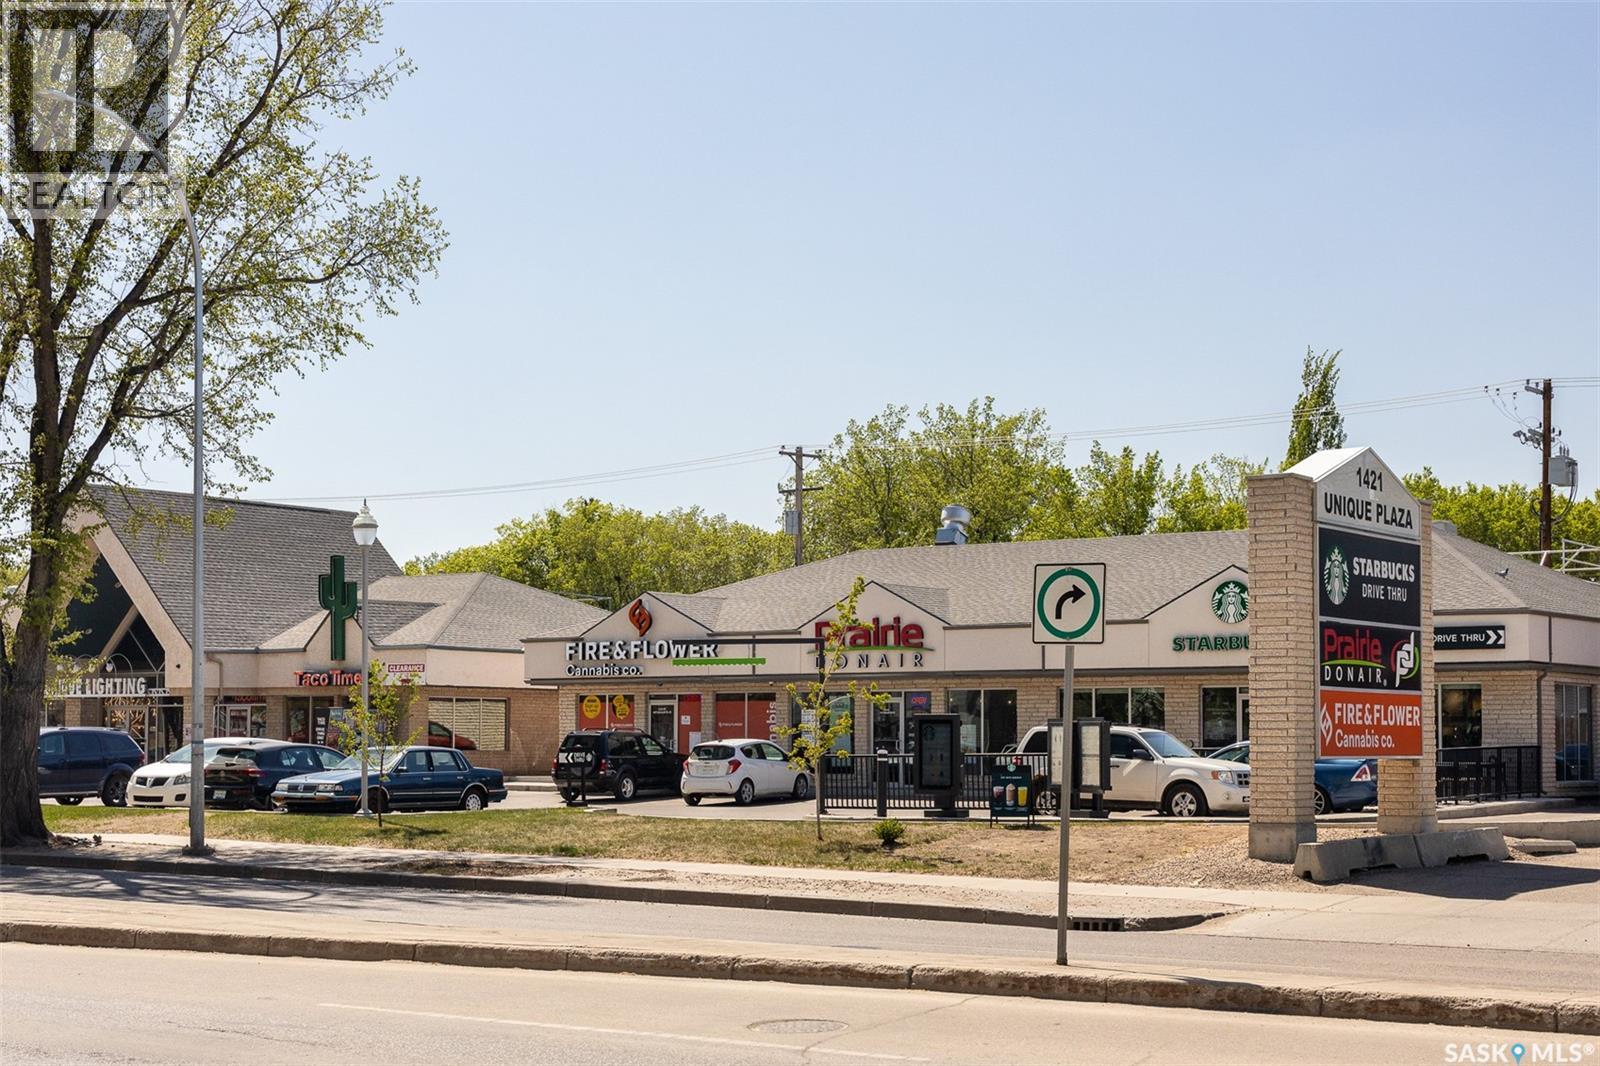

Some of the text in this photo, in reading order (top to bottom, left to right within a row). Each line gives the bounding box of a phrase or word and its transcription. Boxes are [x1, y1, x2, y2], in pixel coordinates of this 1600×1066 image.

[1356, 467, 1383, 492] 1421
[1324, 492, 1413, 529] UNIQUE PLAZA
[1352, 557, 1415, 582] STARBUCKS
[1362, 583, 1407, 602] DRIVE THRU
[1324, 628, 1383, 662] Prairie
[1460, 633, 1486, 642] THRU
[389, 664, 424, 672] CLEARANCE
[815, 652, 924, 669] ONAIR
[294, 669, 363, 687] Taco Time
[565, 664, 643, 677] Cannabis co.
[85, 678, 146, 694] LIGHTING
[1334, 703, 1420, 727] FIRE&FLOWER
[1335, 729, 1395, 748] Cannabis co.
